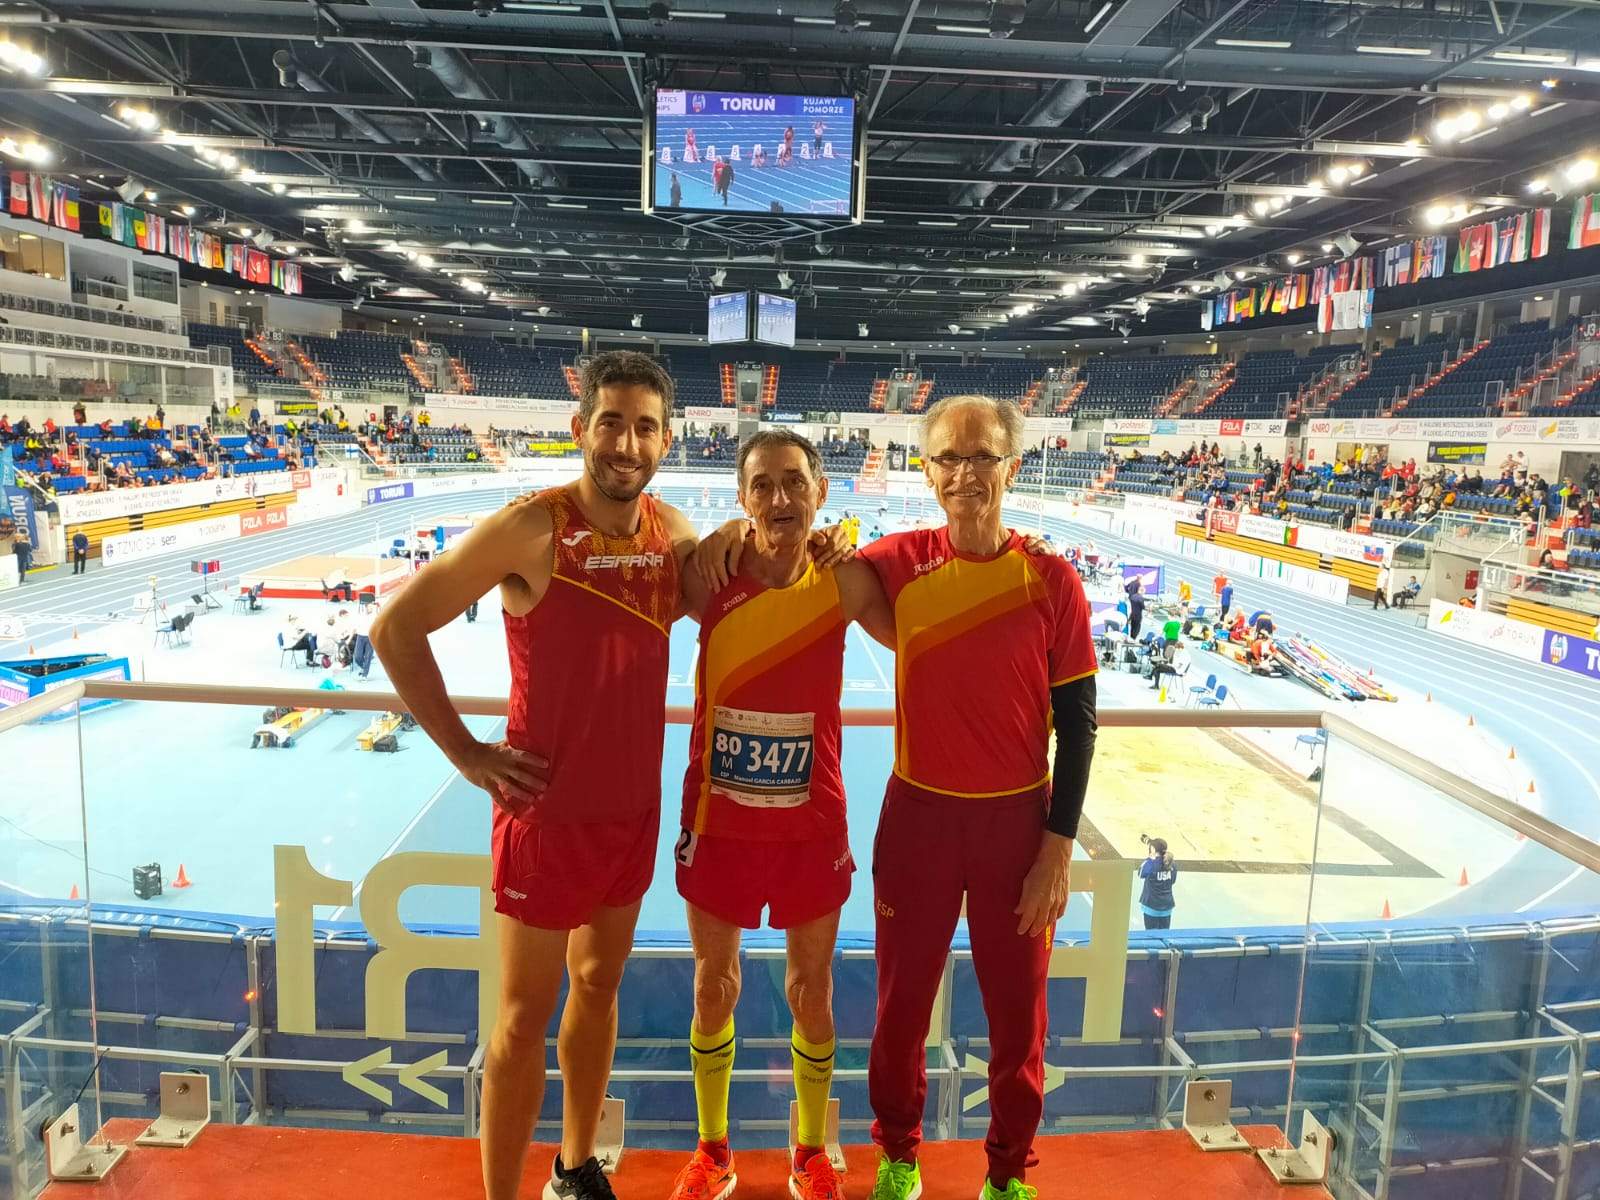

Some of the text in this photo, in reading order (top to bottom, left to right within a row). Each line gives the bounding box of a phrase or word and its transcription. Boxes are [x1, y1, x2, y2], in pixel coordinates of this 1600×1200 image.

[720, 96, 776, 111] TORUŃ
[803, 106, 844, 114] POMORZE
[686, 409, 712, 417] ANIRO
[1222, 422, 1241, 431] PZLA
[1311, 423, 1330, 433] ANIRO
[379, 484, 405, 500] TORUŃ
[242, 511, 287, 528] PZLA PZLA
[584, 552, 664, 569] ESPAÑA
[1483, 566, 1497, 584] L1
[715, 733, 811, 774] 80 3477
[721, 755, 733, 769] M
[678, 828, 692, 862] 2
[1156, 871, 1172, 881] USA
